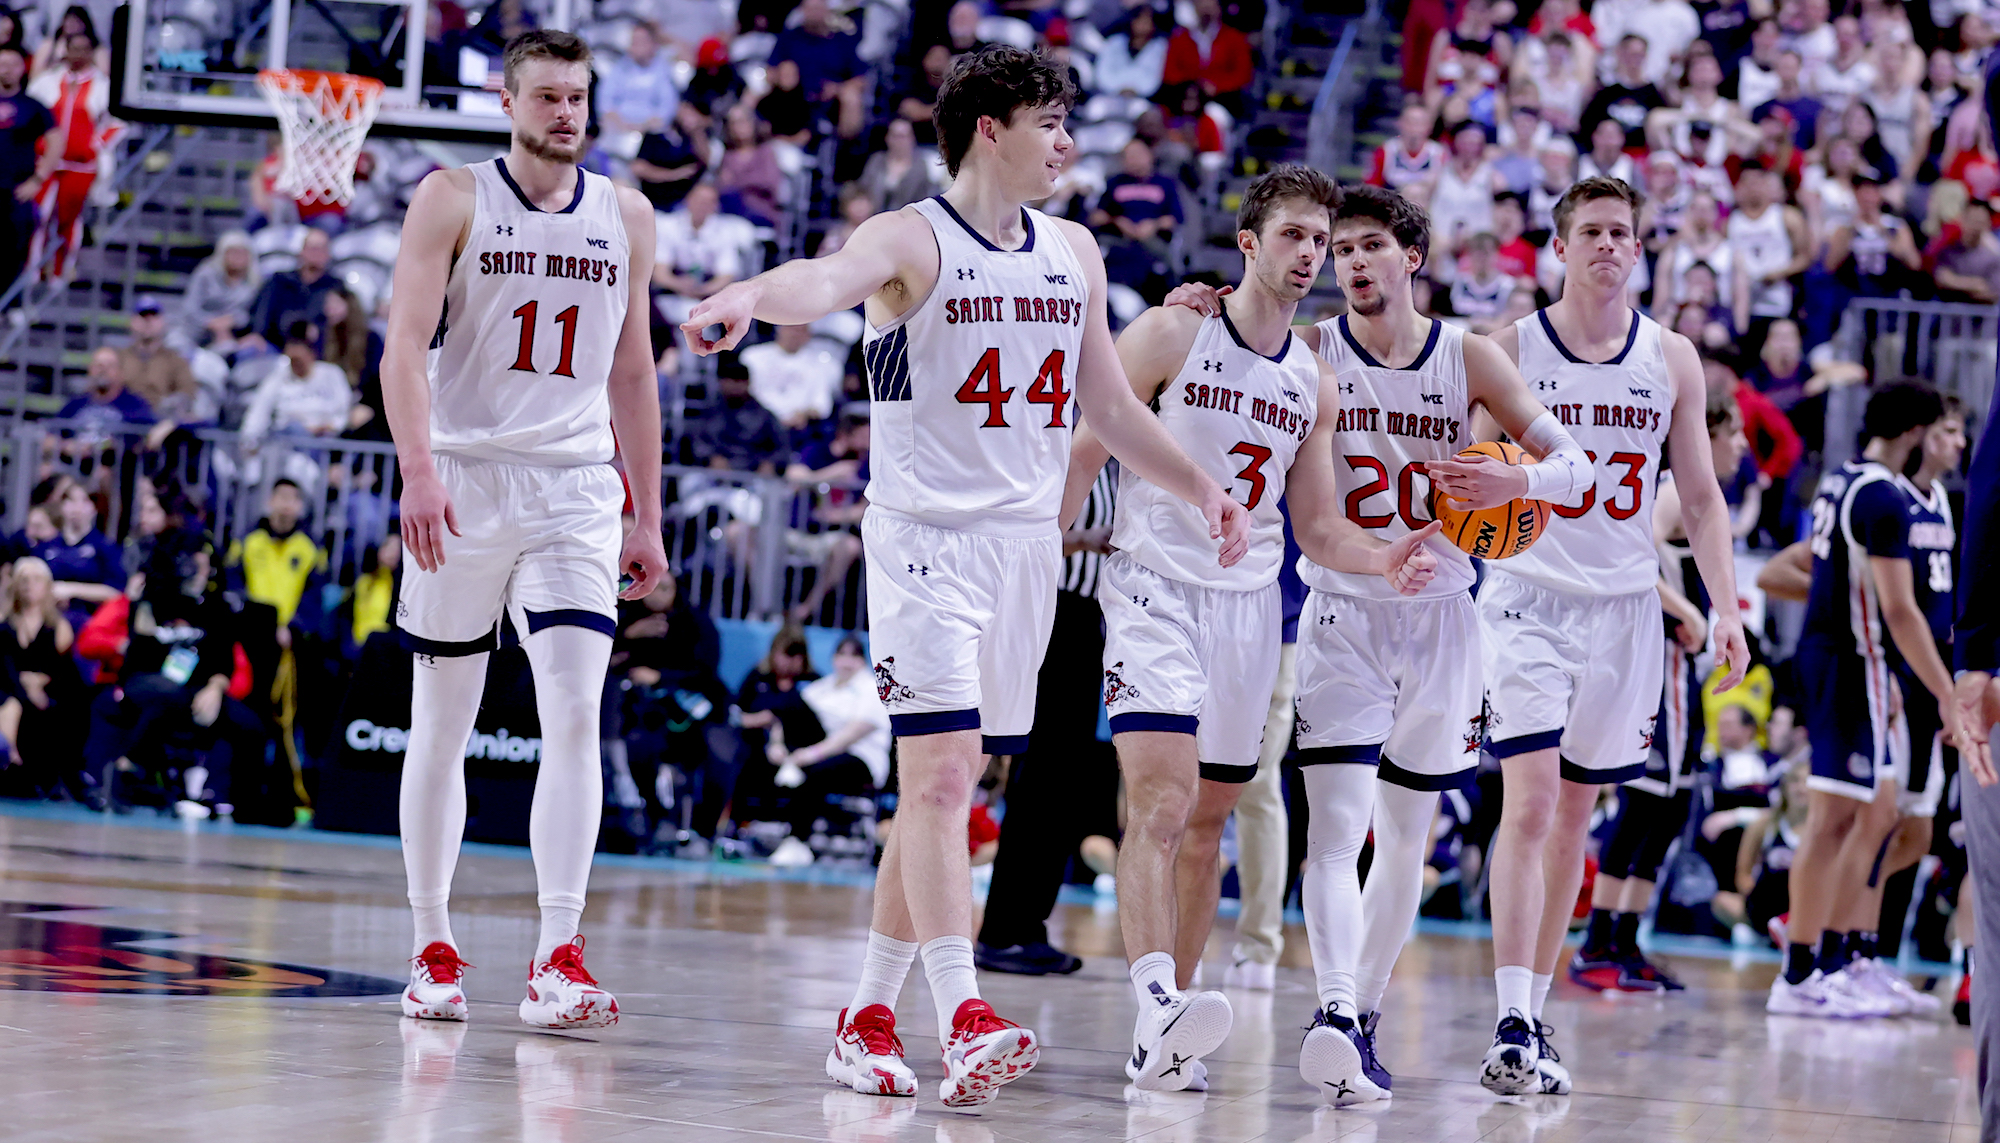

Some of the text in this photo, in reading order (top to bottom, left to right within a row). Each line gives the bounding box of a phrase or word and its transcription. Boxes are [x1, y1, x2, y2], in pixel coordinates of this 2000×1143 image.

[586, 237, 609, 250] WCC
[479, 251, 618, 287] SAINT MARY'S
[1044, 274, 1068, 285] WCC
[945, 296, 1082, 327] SAINT MARY'S
[507, 300, 580, 379] 11
[954, 347, 1071, 429] 44
[1420, 393, 1443, 405] WCC
[1628, 387, 1652, 399] WCC
[1183, 382, 1310, 442] SAINT MARY'S
[1336, 407, 1460, 444] AINT MARY'S
[1593, 404, 1662, 433] MARY'S
[1225, 441, 1273, 512] 3
[1343, 454, 1438, 531] 20
[345, 718, 412, 754] Cre
